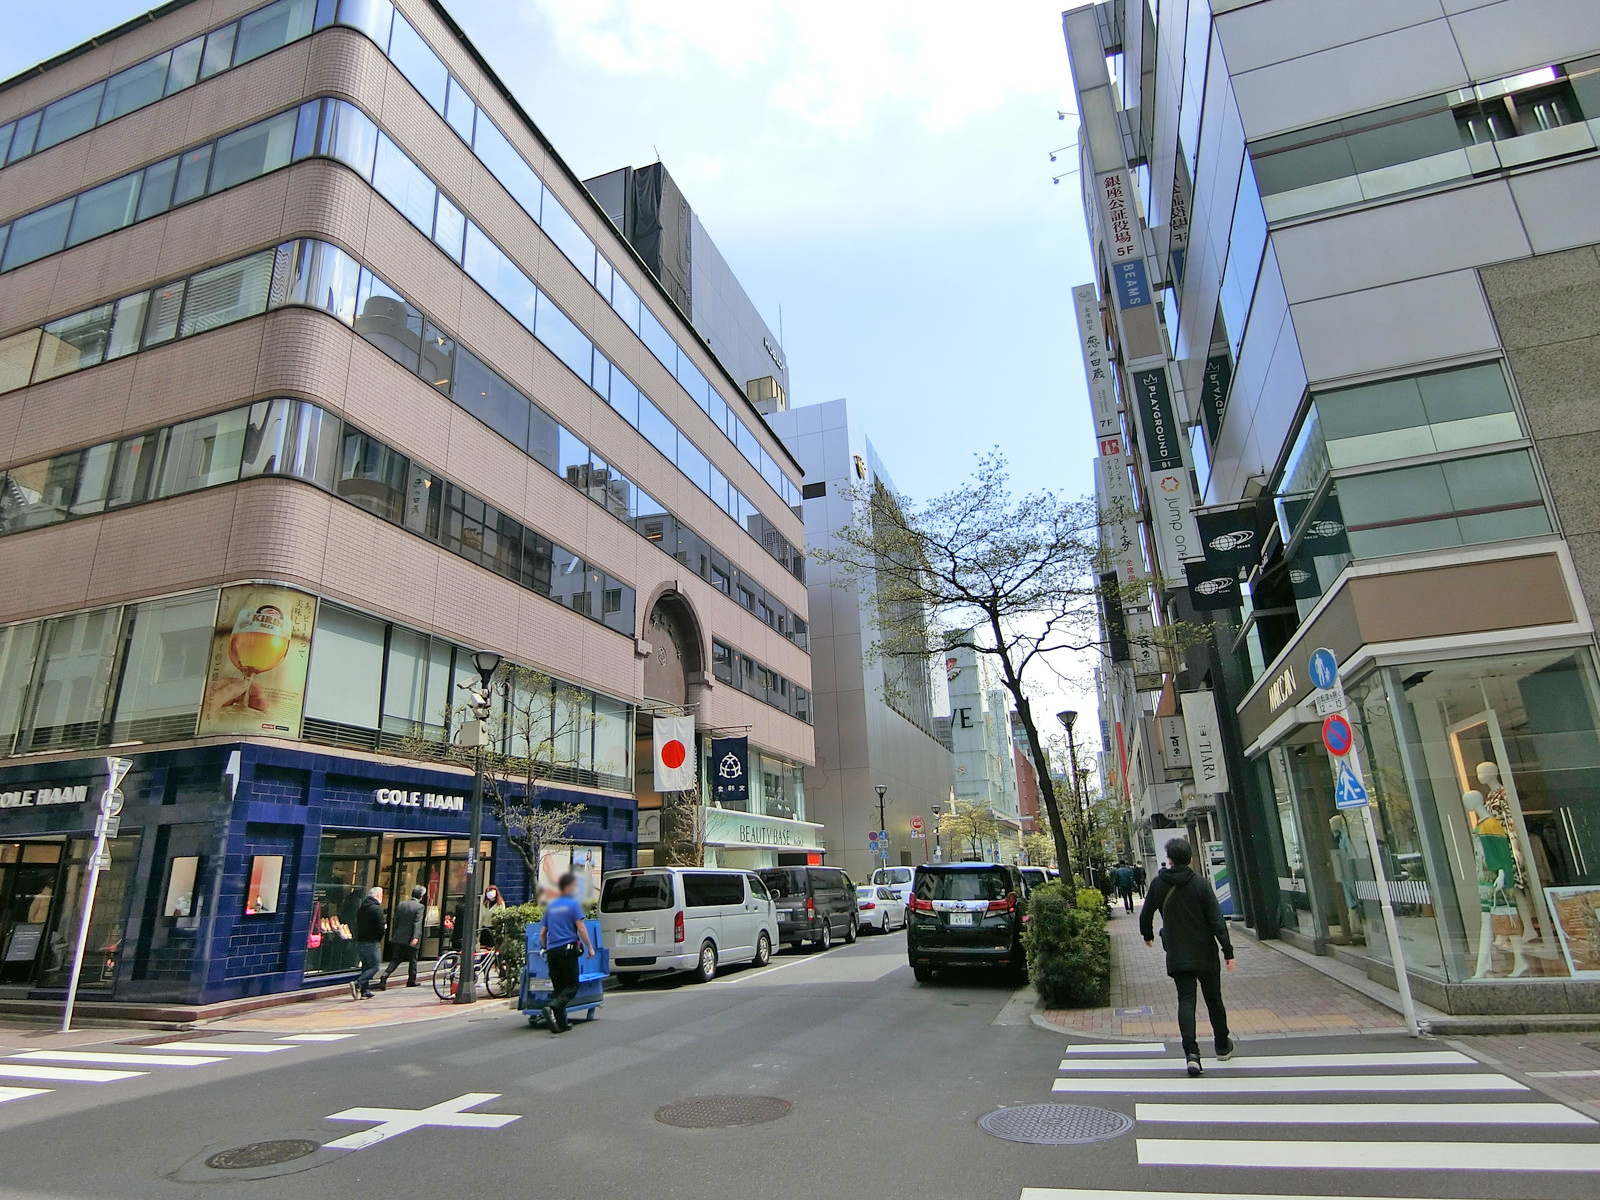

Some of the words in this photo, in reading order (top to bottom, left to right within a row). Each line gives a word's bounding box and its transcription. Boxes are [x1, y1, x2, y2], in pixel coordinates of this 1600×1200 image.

[1104, 175, 1132, 243] 銀座公証役場
[1117, 245, 1134, 257] 5F
[1123, 263, 1141, 305] BEAMS
[1100, 418, 1113, 428] 7F
[1148, 385, 1169, 458] PLAYGROUND
[1161, 460, 1172, 468] B1
[1164, 497, 1183, 531] jump
[252, 614, 285, 629] KIRIN
[1199, 740, 1217, 781] TIARA
[0, 790, 36, 808] OLE
[36, 785, 88, 806] HAAN
[376, 788, 420, 807] COLE
[423, 793, 464, 810] HAAN
[739, 824, 772, 845] BEAUTY
[773, 829, 791, 846] BASE
